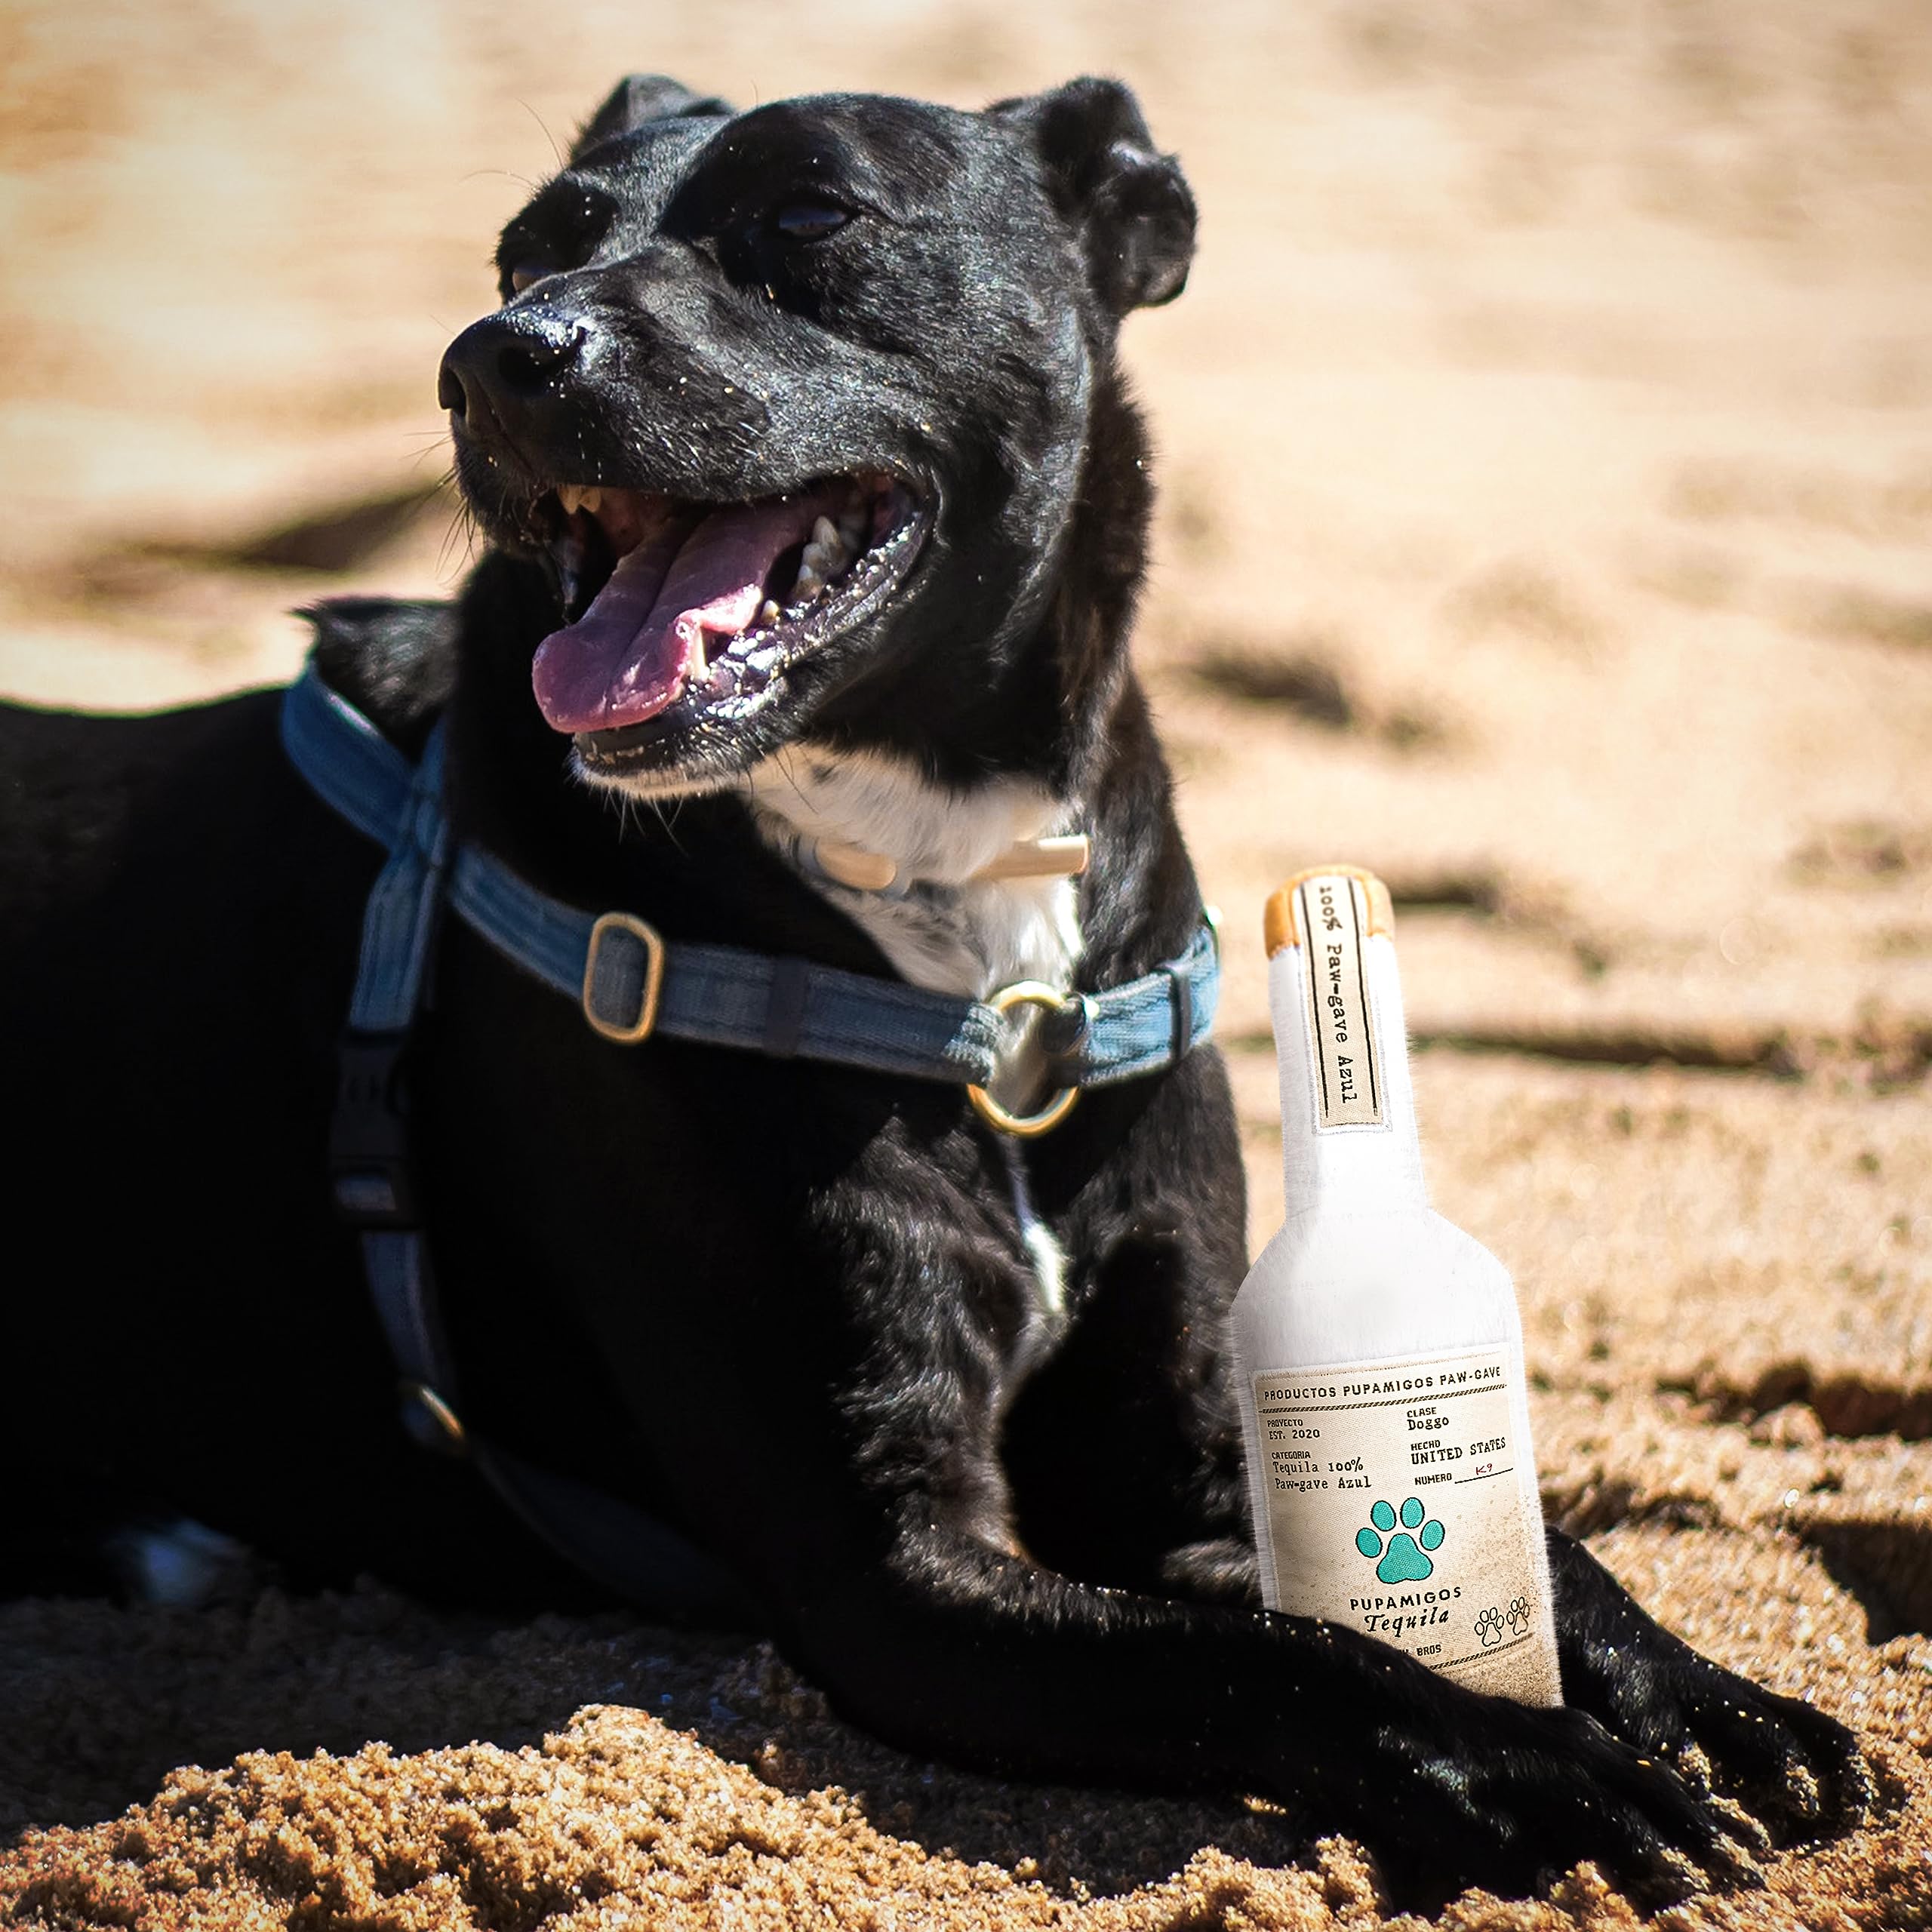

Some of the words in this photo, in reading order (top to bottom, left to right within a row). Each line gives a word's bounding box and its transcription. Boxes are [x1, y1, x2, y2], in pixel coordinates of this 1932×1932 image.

[1319, 884, 1343, 932] 100%
[1327, 943, 1348, 1043] Paw-gave
[1337, 1055, 1358, 1104] Azul
[1263, 1386, 1337, 1401] PRODUCTOS
[1343, 1377, 1434, 1397] PUPAMIGOS
[1439, 1366, 1501, 1386] PAW-GAVE
[1406, 1407, 1437, 1418] CLASE
[1266, 1418, 1303, 1428] PROYECTO
[1407, 1417, 1450, 1431] Doggo
[1268, 1430, 1286, 1440] EST.
[1291, 1429, 1320, 1439] 2020
[1411, 1439, 1441, 1451] HECHO
[1411, 1447, 1463, 1465] UNITED
[1469, 1437, 1506, 1455] STATES
[1271, 1451, 1311, 1460] CATEGORIA
[1272, 1460, 1319, 1474] Tequila
[1327, 1457, 1364, 1472] 100%
[1275, 1477, 1328, 1493] Paw-gave
[1337, 1475, 1372, 1489] Azul
[1414, 1472, 1453, 1485] NUMERO
[1349, 1586, 1462, 1611] PUPAMIGOS
[1363, 1606, 1450, 1638] Tequila
[1416, 1644, 1442, 1657] BROS
